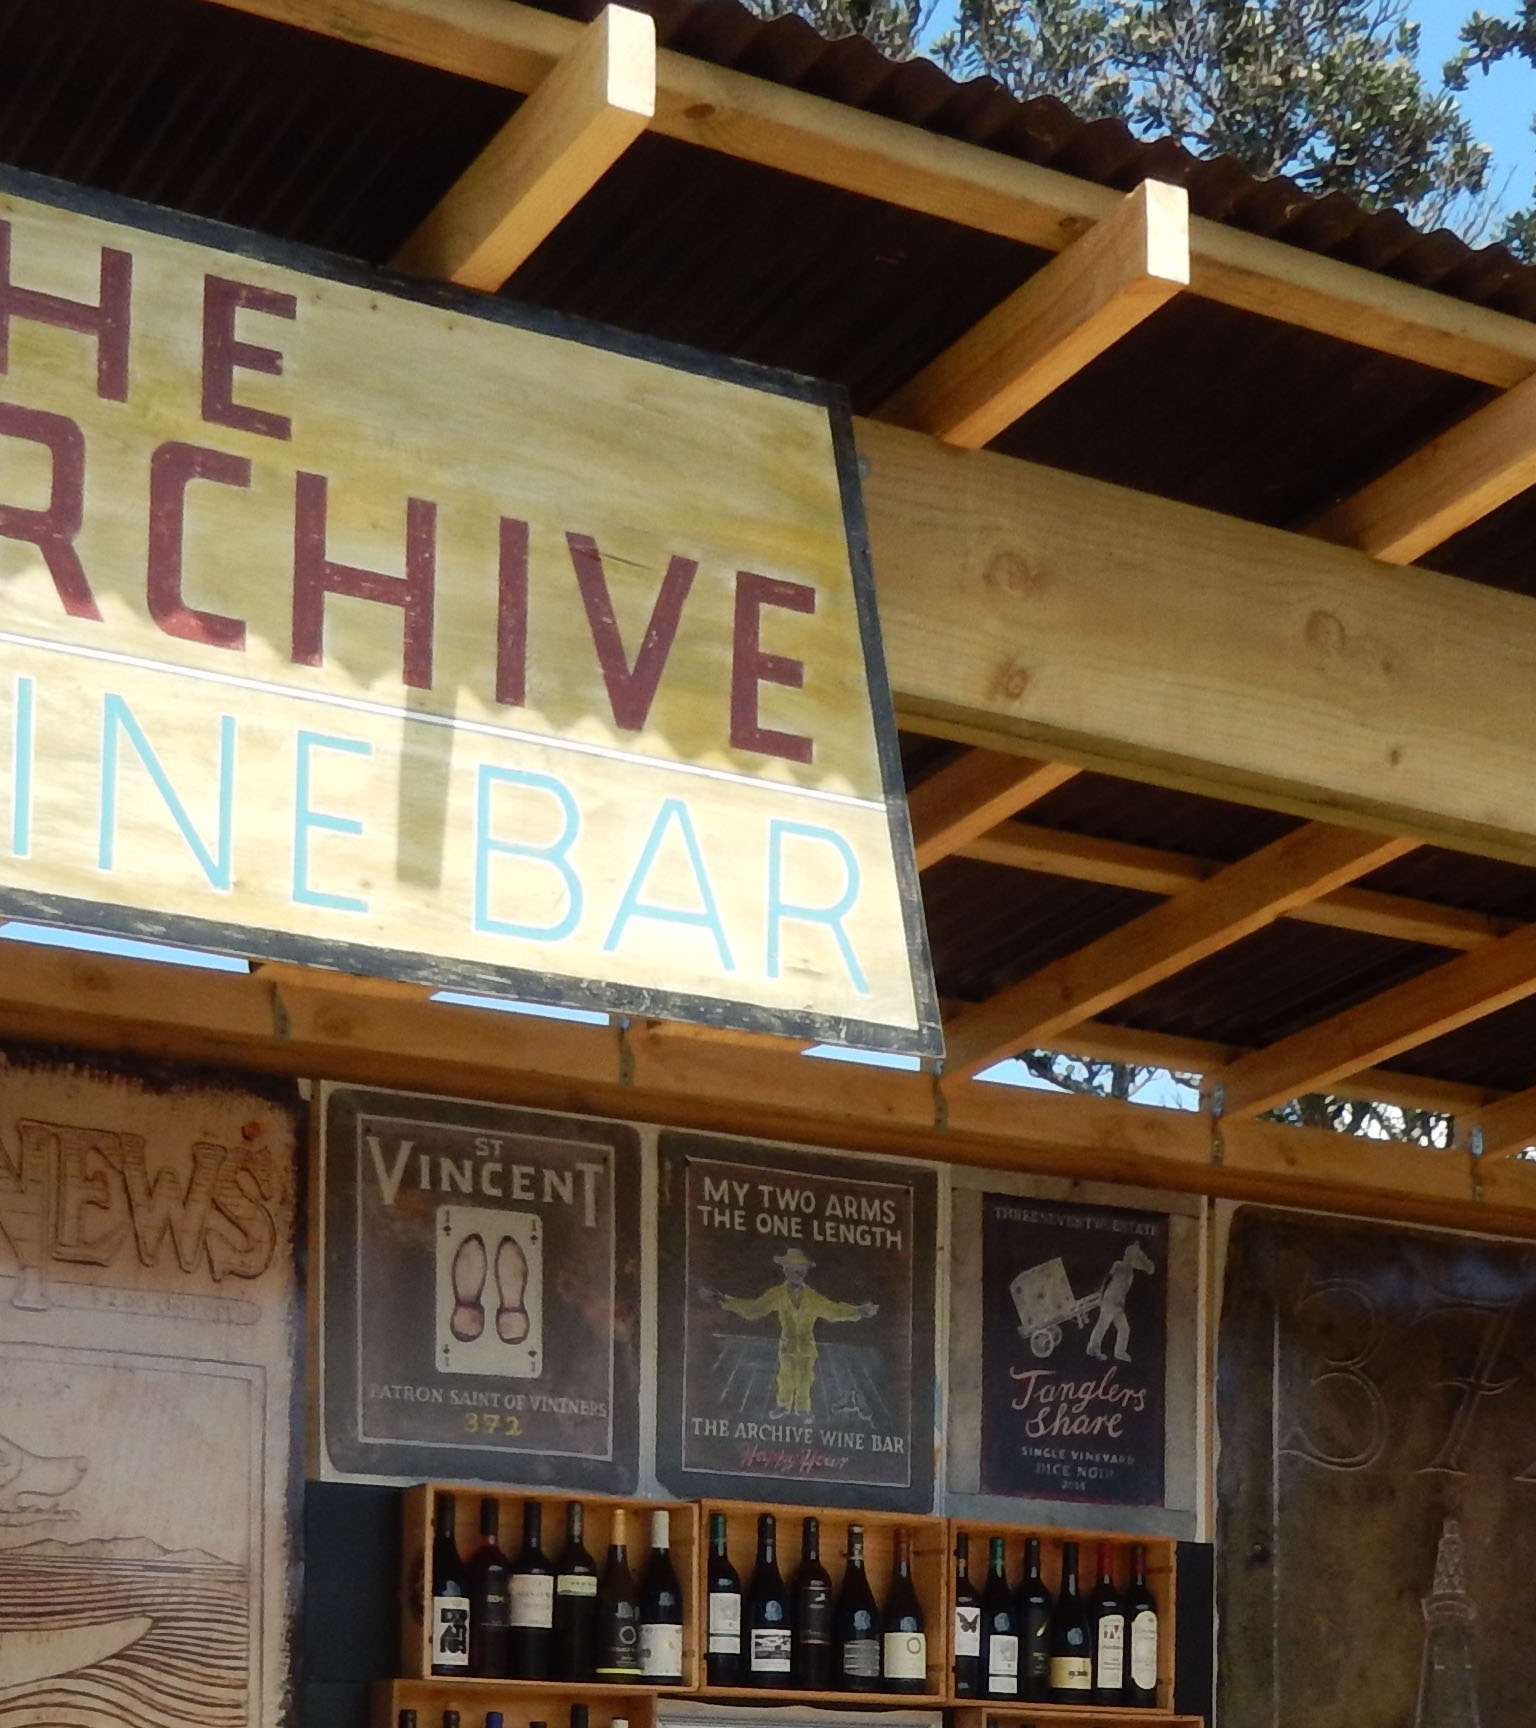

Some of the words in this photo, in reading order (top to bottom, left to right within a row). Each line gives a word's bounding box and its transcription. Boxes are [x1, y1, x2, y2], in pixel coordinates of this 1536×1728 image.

[471, 763, 871, 995] BAR
[475, 1136, 504, 1157] ST
[366, 1135, 605, 1228] VINCENT
[703, 1176, 750, 1206] MY
[758, 1185, 816, 1214] TWO
[825, 1195, 896, 1225] ARMS
[697, 1205, 747, 1232] THE
[755, 1213, 803, 1239] ONE
[813, 1220, 902, 1250] LENGTH
[370, 1383, 443, 1403] PATRON
[450, 1389, 500, 1409] SAINT
[505, 1394, 525, 1410] OF
[1010, 1366, 1147, 1413] Tanglers
[465, 1413, 523, 1436] 372
[692, 1417, 729, 1437] THE
[734, 1422, 813, 1444] ARCHIVE
[820, 1429, 864, 1450] WINE
[871, 1435, 904, 1454] BAR
[1025, 1403, 1123, 1439] Share
[1021, 1446, 1066, 1460] SINGLE
